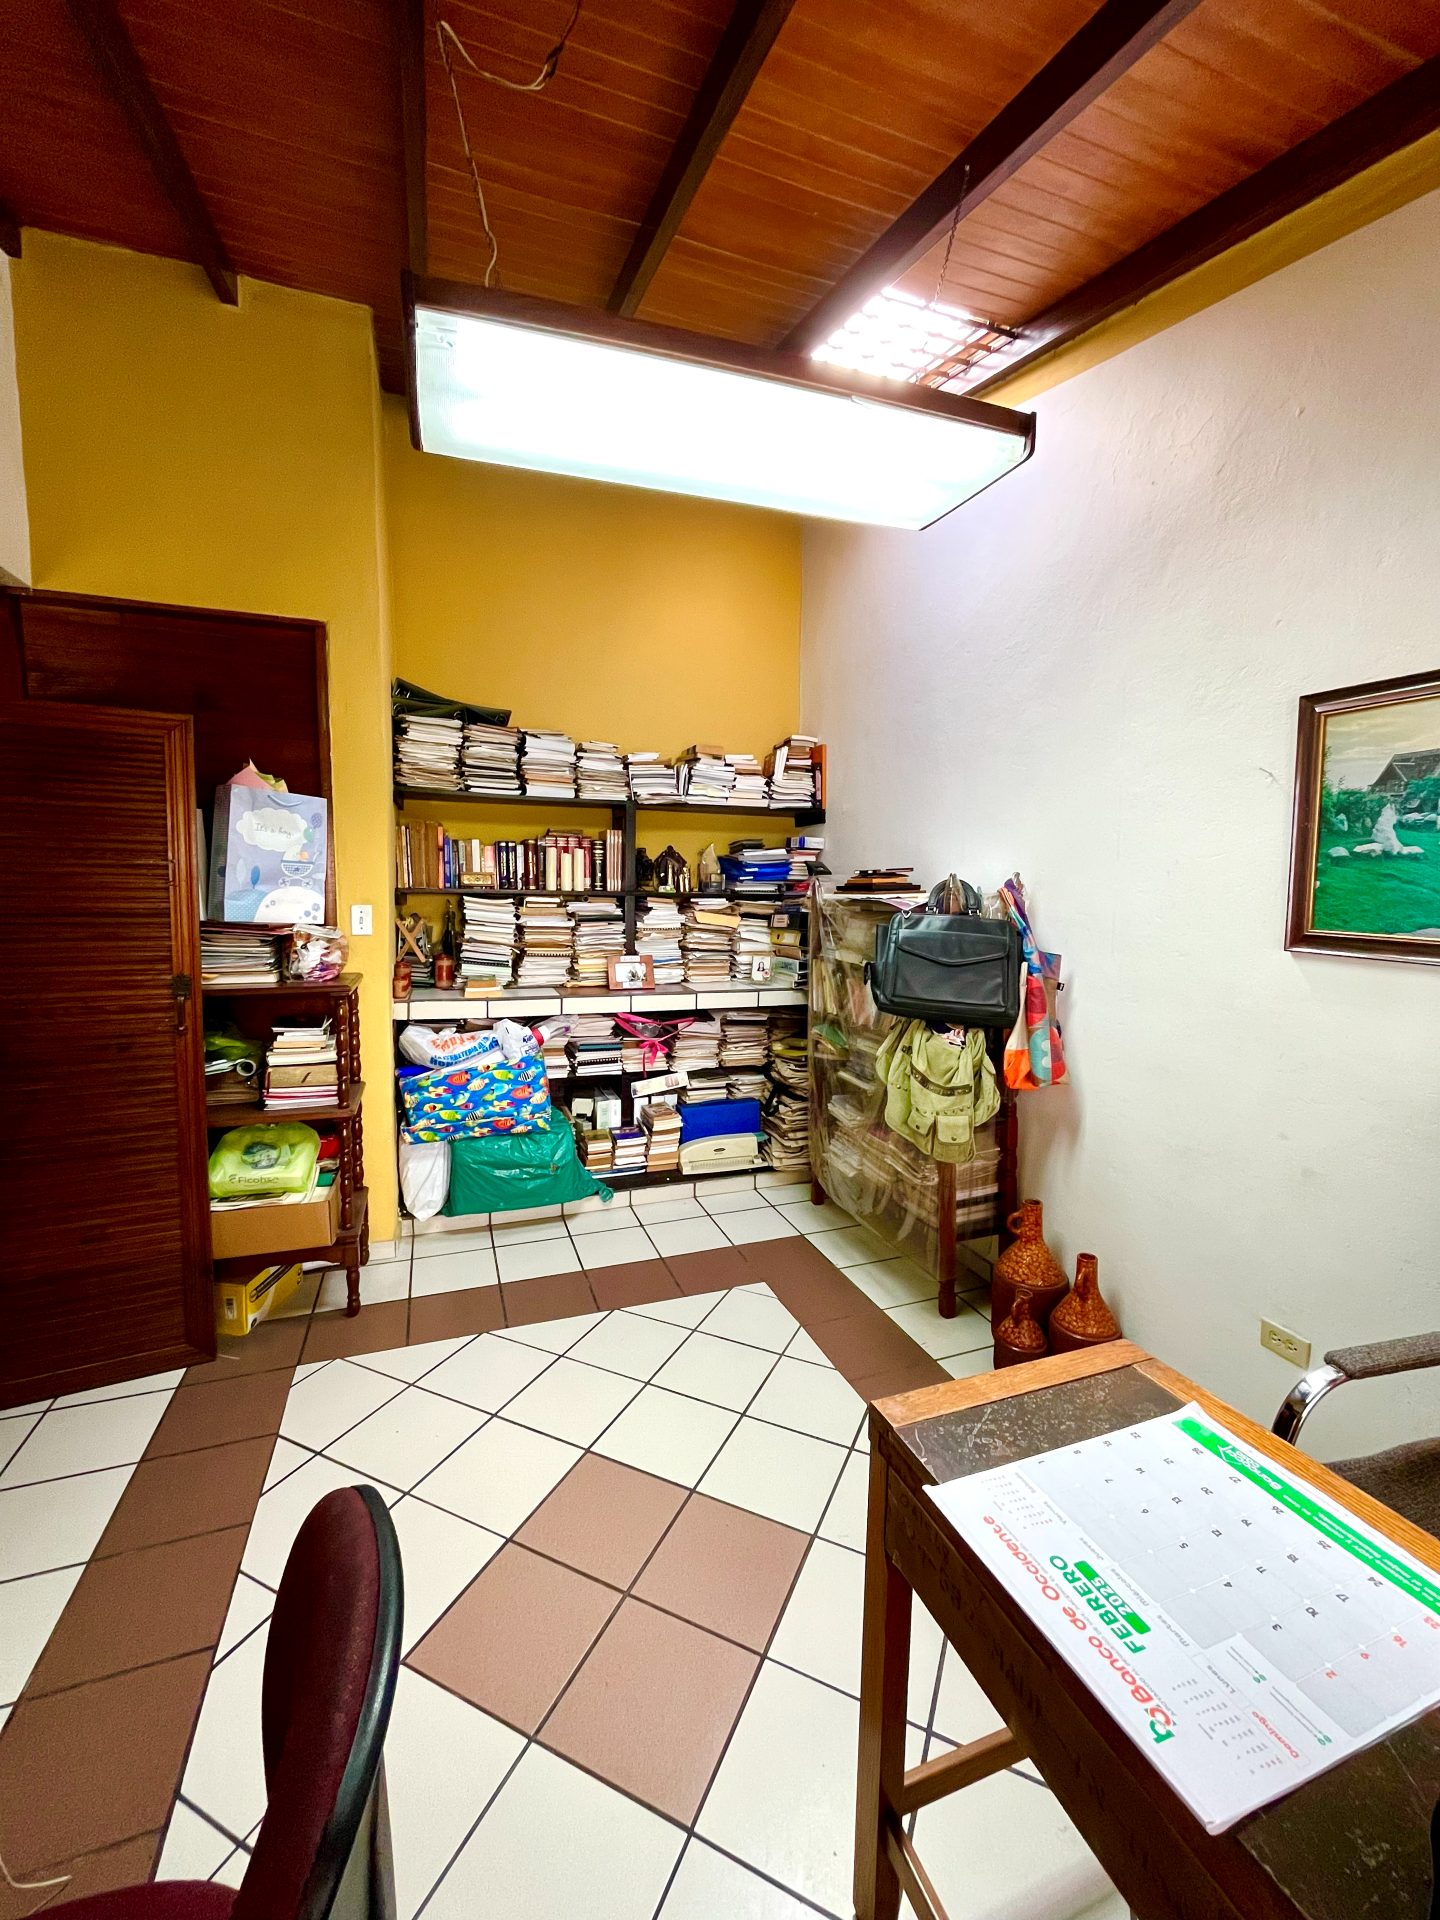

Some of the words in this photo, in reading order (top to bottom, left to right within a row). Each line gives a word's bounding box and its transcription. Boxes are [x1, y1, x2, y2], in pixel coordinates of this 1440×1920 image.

[1191, 1447, 1203, 1455] 28
[1200, 1486, 1213, 1495] 20
[1171, 1496, 1181, 1504] 13
[1271, 1505, 1284, 1514] 26
[1240, 1519, 1252, 1527] 19
[1211, 1529, 1222, 1537] 12
[1316, 1540, 1331, 1549] 25
[983, 1516, 1067, 1600] Occidente
[1286, 1553, 1299, 1563] 18
[1351, 1545, 1375, 1560] HOY
[1367, 1576, 1383, 1587] 24
[1088, 1573, 1132, 1617] 2025
[1335, 1593, 1349, 1602] 17
[1049, 1555, 1145, 1653] FEBRERO
[1305, 1606, 1318, 1617] 10
[1062, 1606, 1086, 1630] de
[1423, 1615, 1440, 1630] 23
[1271, 1623, 1282, 1631] 3
[1393, 1635, 1406, 1647] 16
[1088, 1635, 1153, 1703] Banco
[1325, 1670, 1337, 1679] 2
[1206, 1664, 1236, 1694] Lunes
[1251, 1711, 1299, 1758] Domingo
